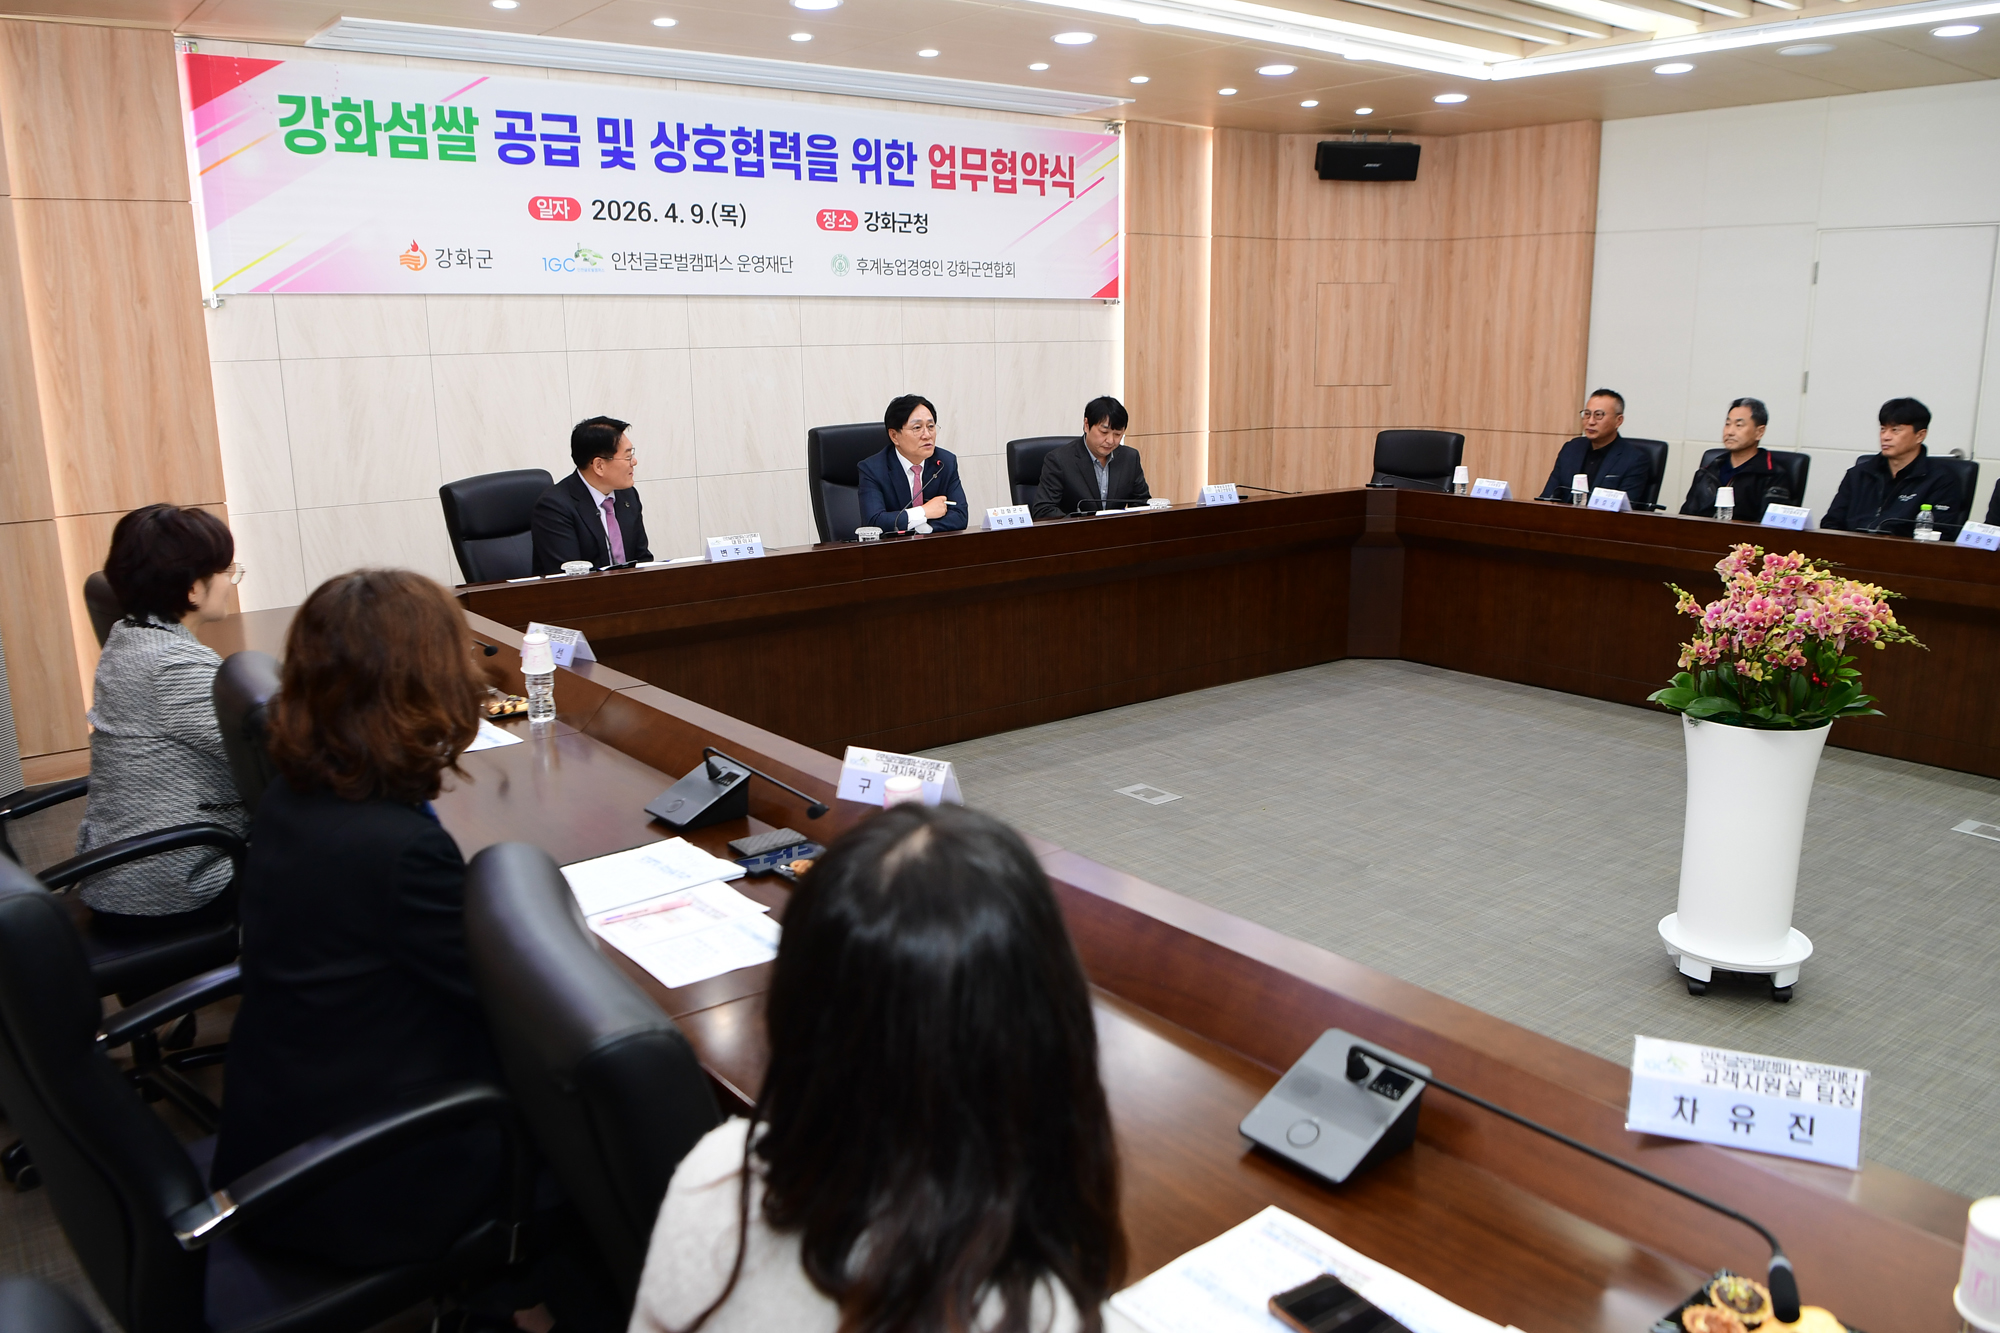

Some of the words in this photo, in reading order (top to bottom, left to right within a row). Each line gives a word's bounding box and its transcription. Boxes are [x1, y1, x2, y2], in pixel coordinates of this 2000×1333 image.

[278, 94, 479, 162] 강화섬쌀
[494, 109, 581, 168] 공급
[597, 117, 636, 171] 및
[650, 121, 838, 183] 상호협력을
[852, 138, 918, 187] 위한
[928, 143, 1076, 198] 업무협약식
[535, 198, 571, 220] 일자
[822, 211, 853, 230] 장소
[864, 211, 928, 234] 강화군청
[435, 247, 494, 269] 강화군
[611, 251, 733, 272] 인천글로벌캠퍼스
[737, 255, 793, 273] 운영재단
[856, 257, 943, 276] 후계농업경영인
[947, 260, 1016, 279] 강화군연합회
[1702, 1067, 1803, 1099] 고객지원실
